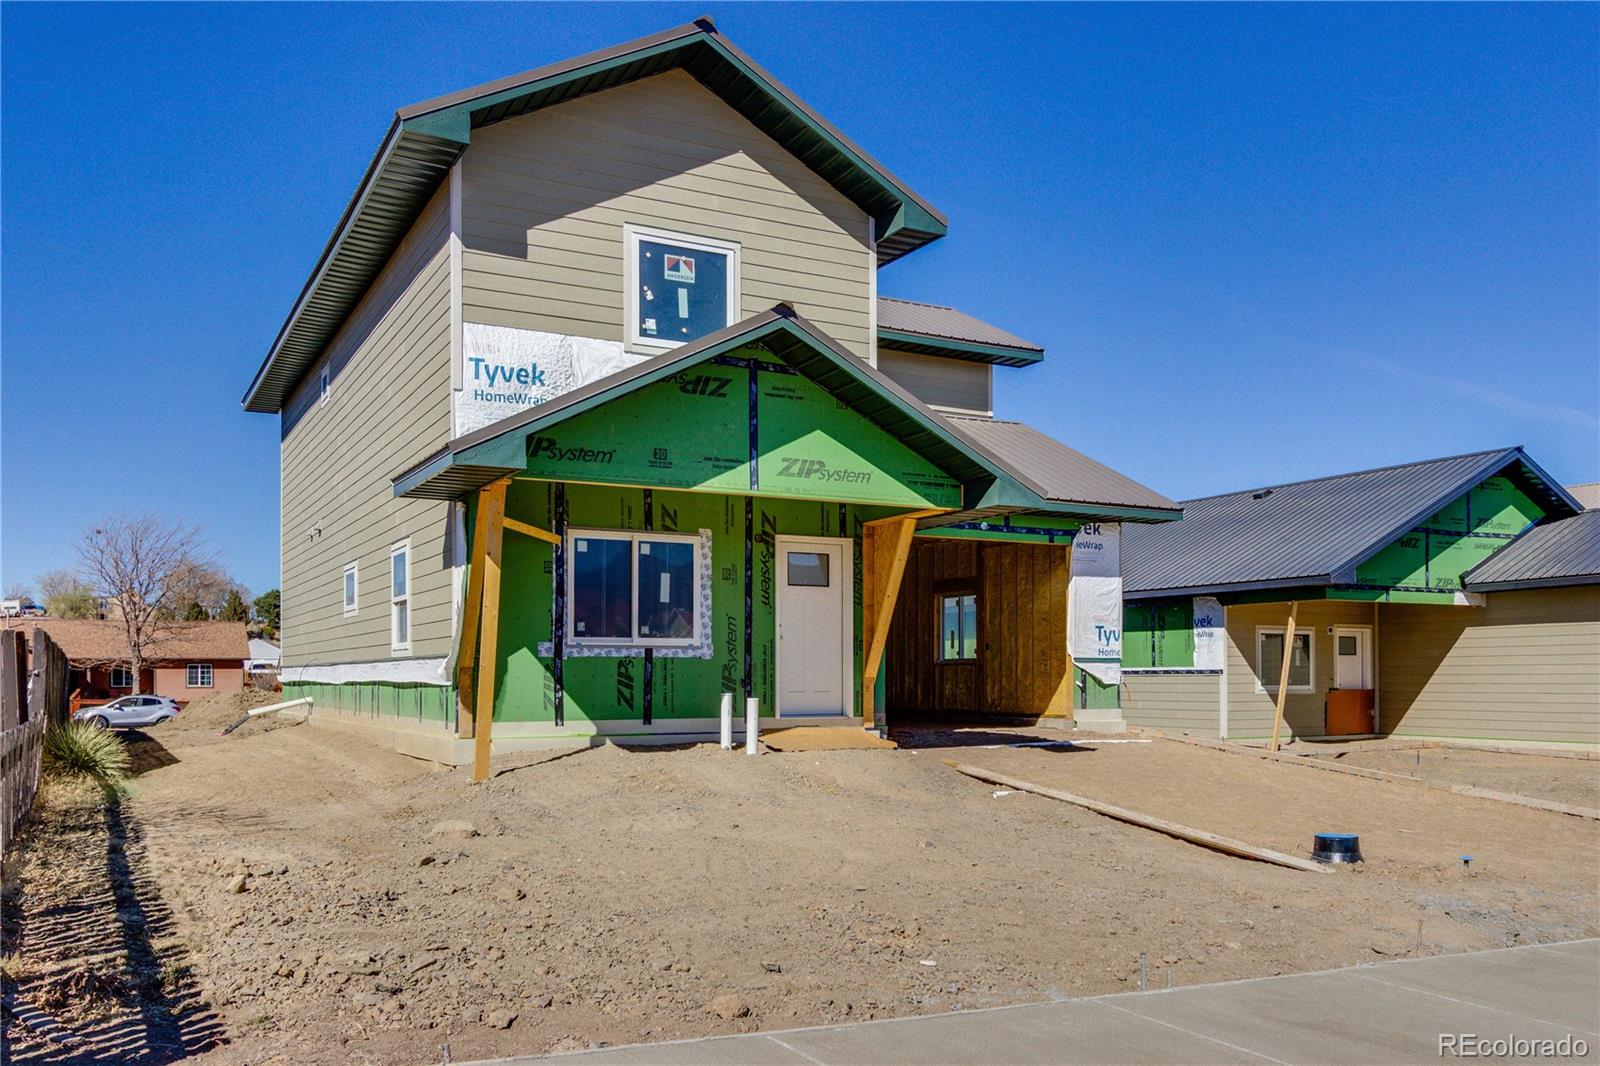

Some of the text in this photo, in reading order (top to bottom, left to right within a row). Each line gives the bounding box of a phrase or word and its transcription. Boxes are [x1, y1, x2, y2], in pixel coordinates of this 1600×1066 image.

[468, 356, 545, 388] Tyvek
[776, 457, 871, 483] ZIPsystem
[1079, 524, 1101, 535] ek
